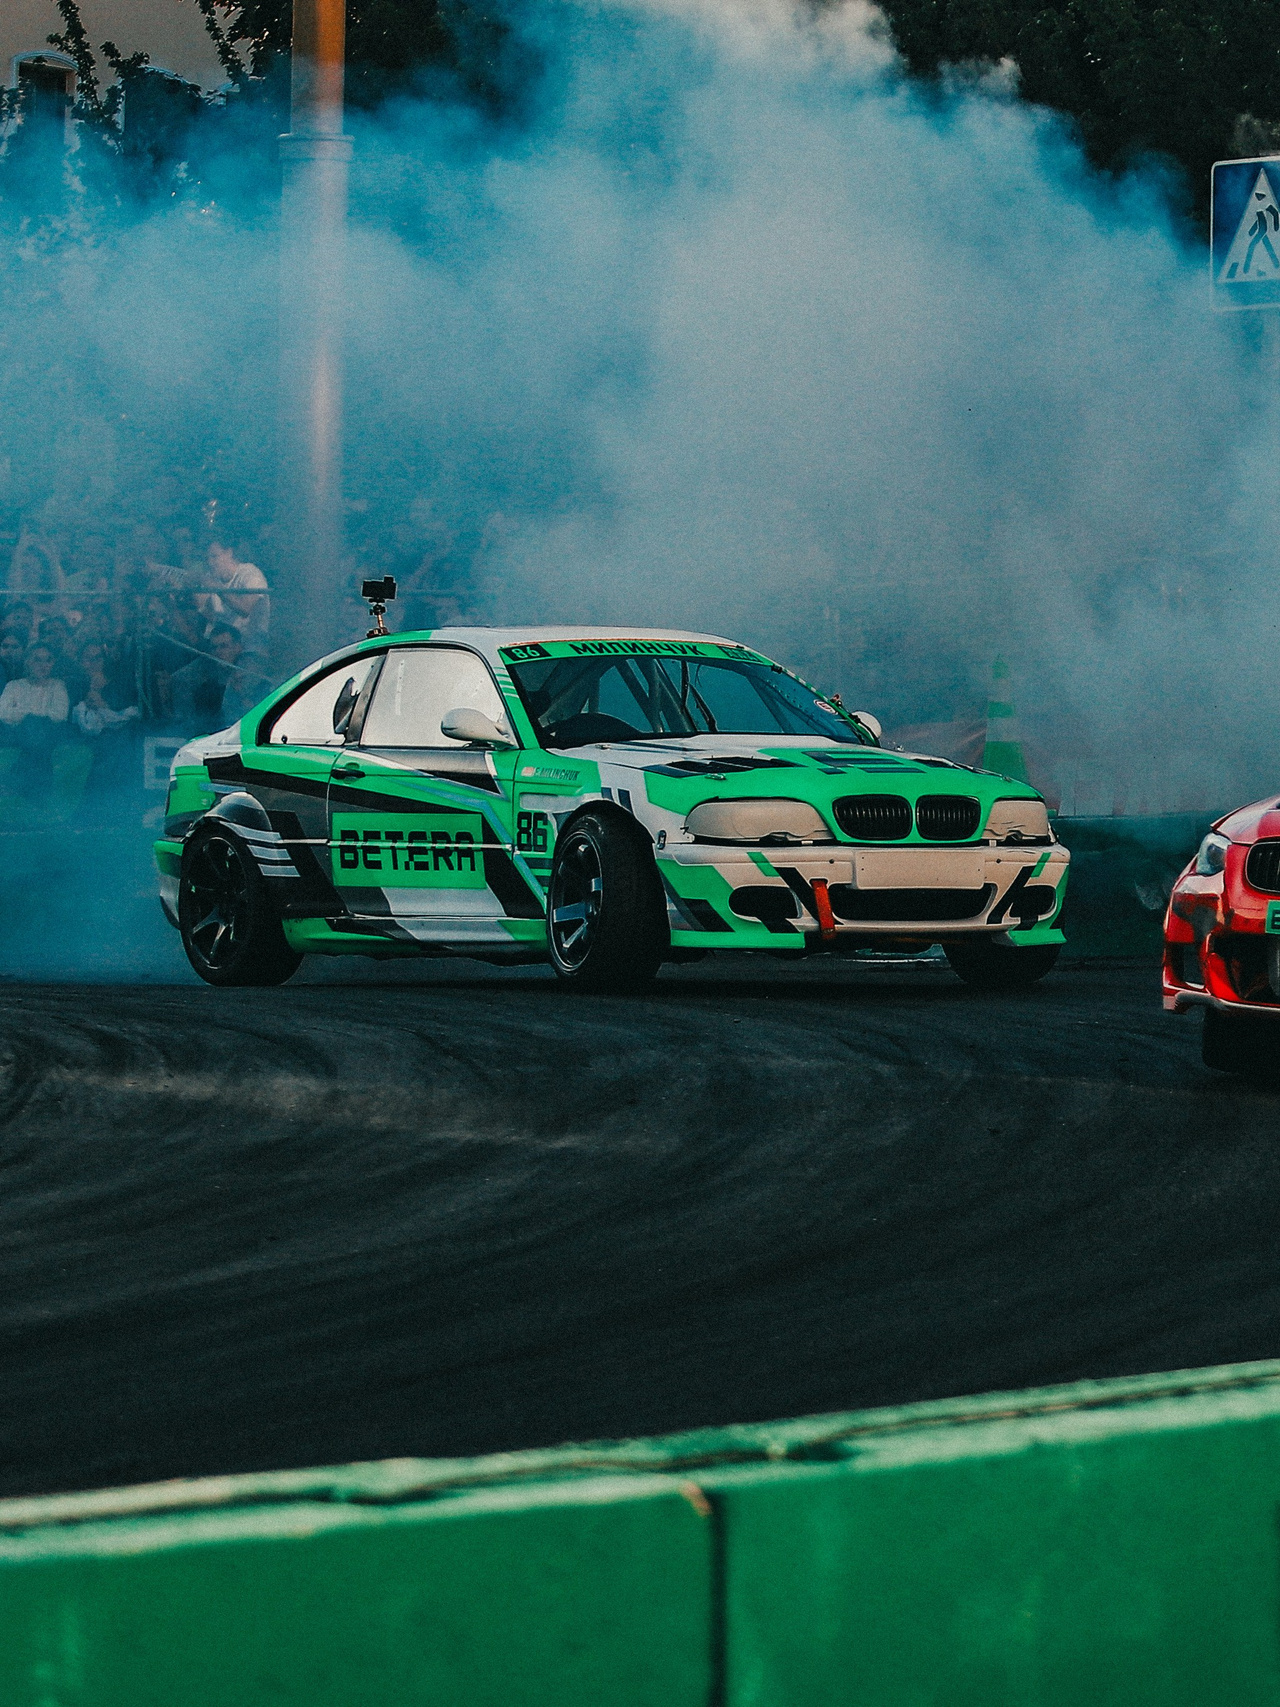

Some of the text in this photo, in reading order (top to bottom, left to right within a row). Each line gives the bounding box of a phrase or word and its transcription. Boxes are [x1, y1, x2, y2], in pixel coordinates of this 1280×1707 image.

[518, 646, 541, 660] 86
[569, 640, 706, 656] МИЛИНЧУК
[517, 811, 548, 853] 86
[340, 829, 477, 872] BET.ERA
